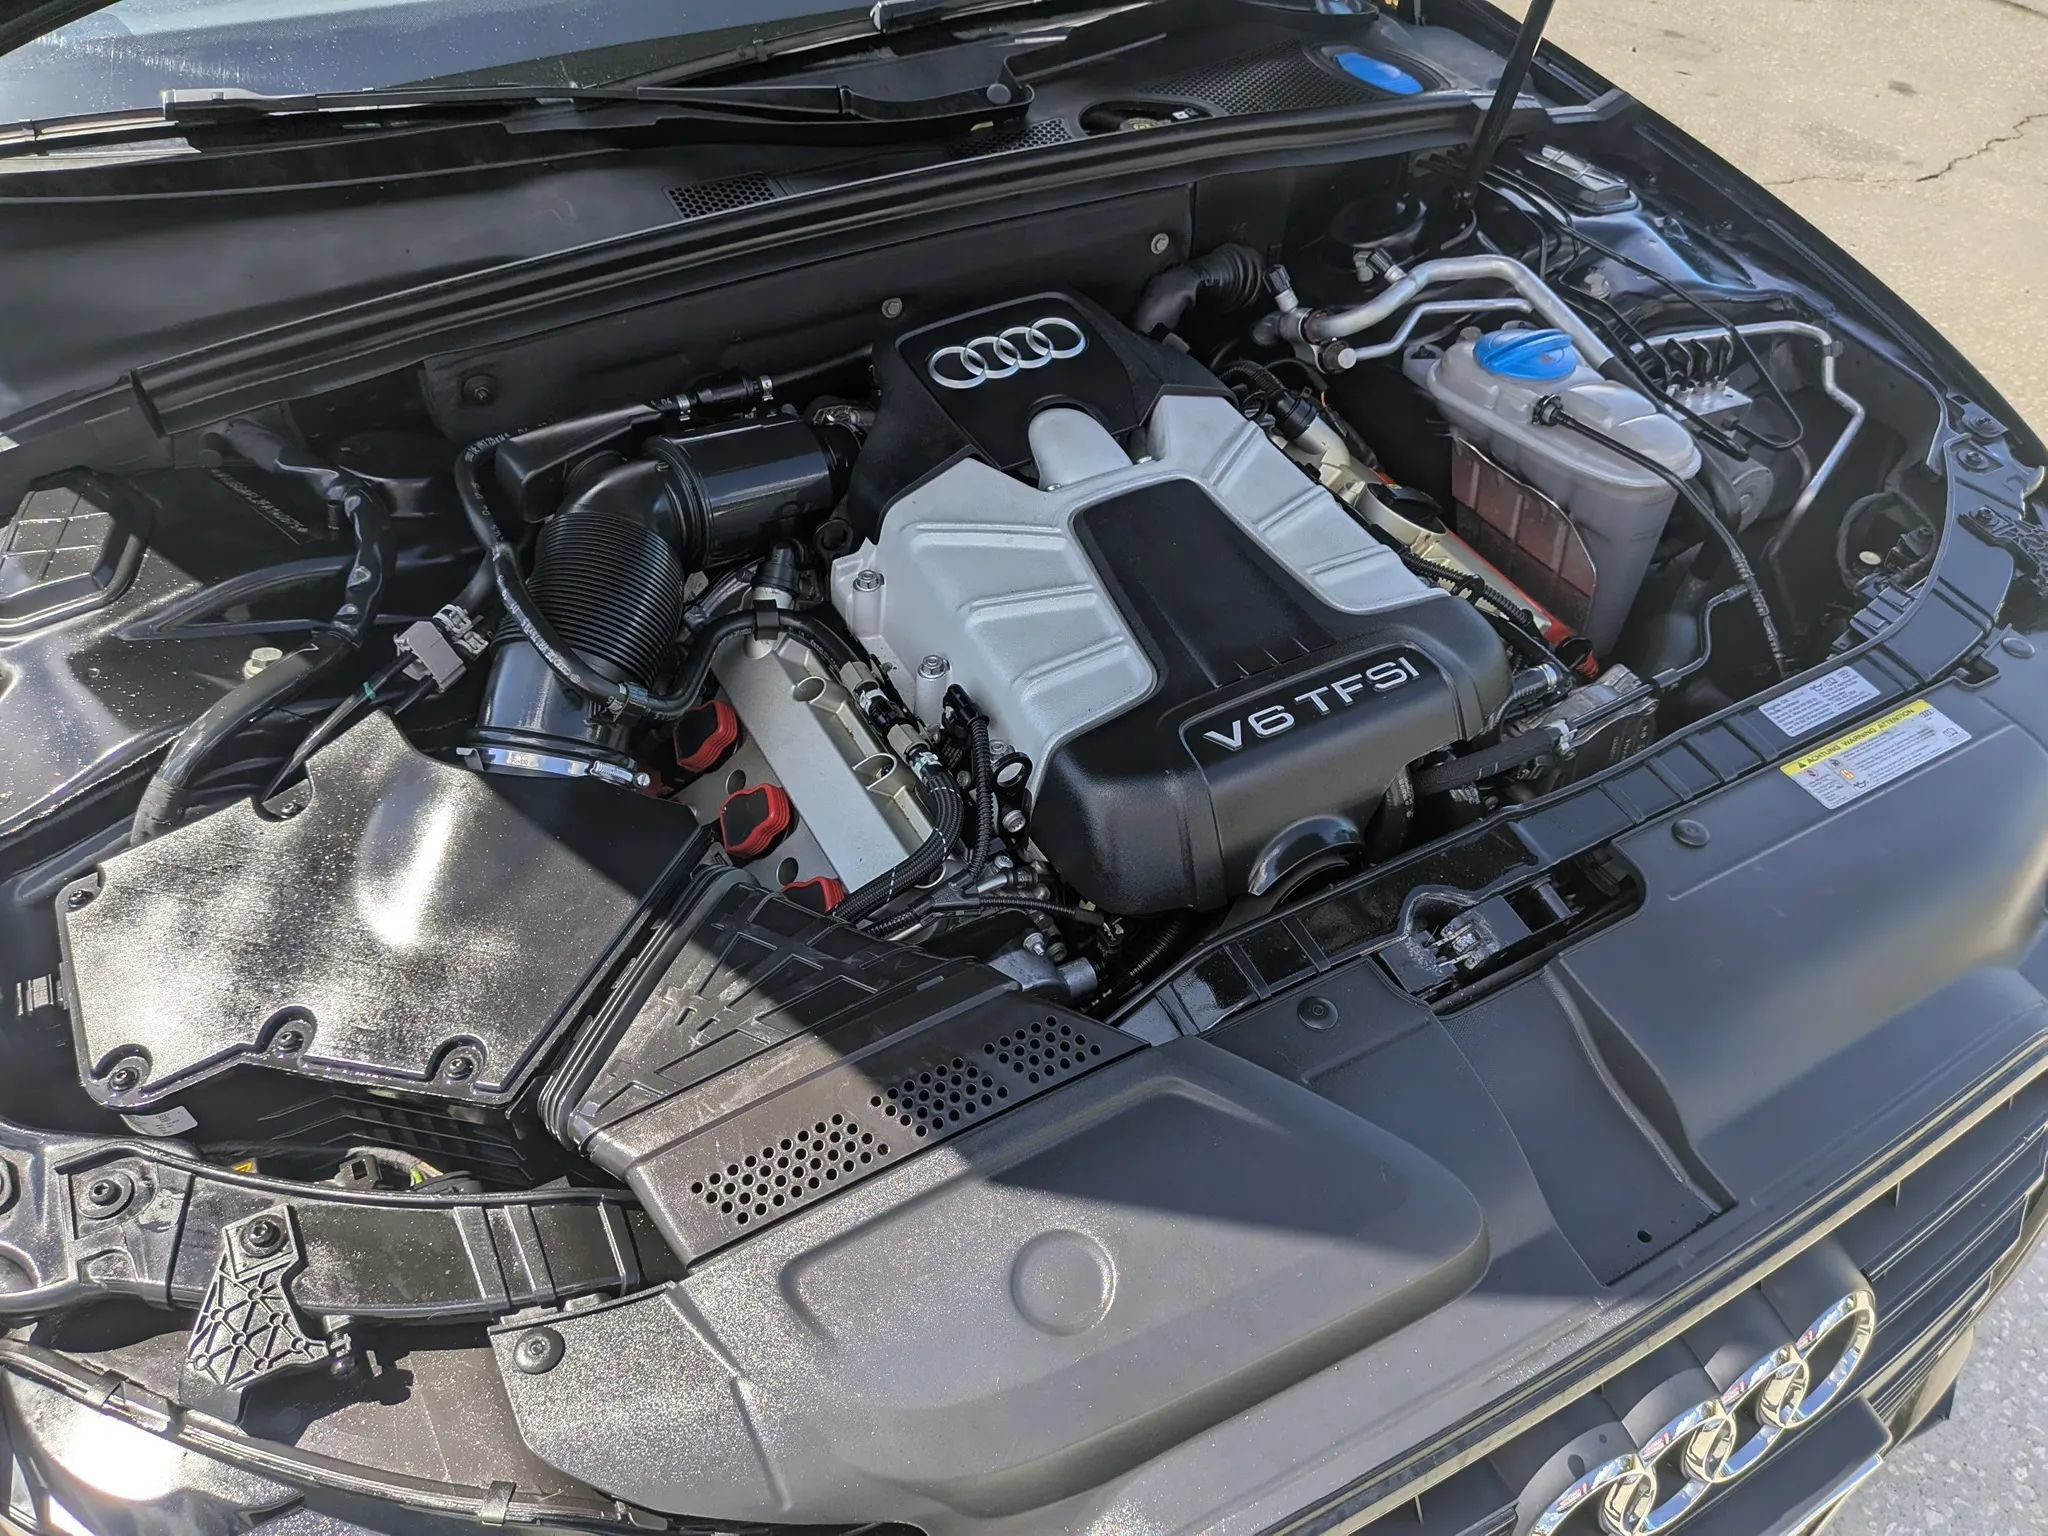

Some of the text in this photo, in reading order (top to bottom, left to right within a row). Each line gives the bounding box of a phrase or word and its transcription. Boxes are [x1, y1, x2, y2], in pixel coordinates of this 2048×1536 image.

[1203, 656, 1420, 751] V6 TFSI
[1806, 708, 1915, 764] ACHTUNG WARNING ATTENTION
